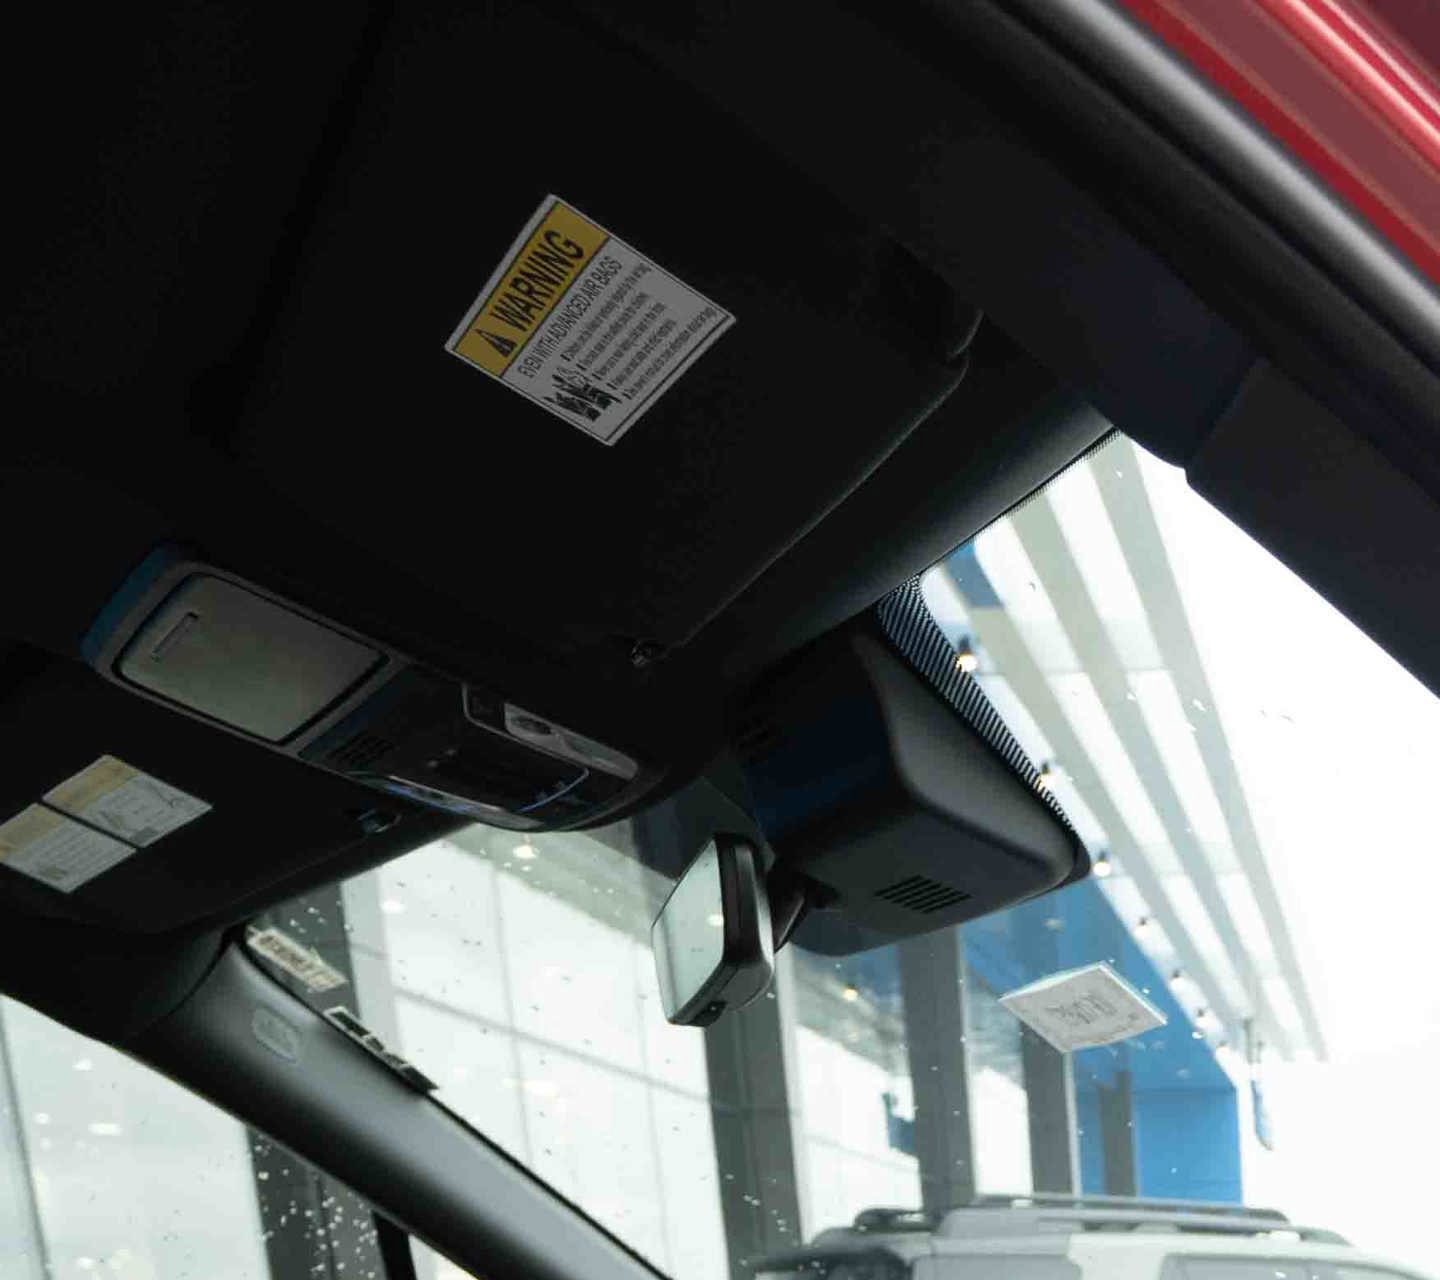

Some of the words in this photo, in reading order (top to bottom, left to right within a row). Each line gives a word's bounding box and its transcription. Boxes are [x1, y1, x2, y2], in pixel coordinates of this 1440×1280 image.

[489, 230, 584, 332] WARNING
[590, 255, 622, 285] BAGS
[578, 278, 603, 301] AIR
[546, 293, 592, 340] ADVANCED
[531, 333, 561, 360] WITH
[518, 351, 546, 378] EVEN
